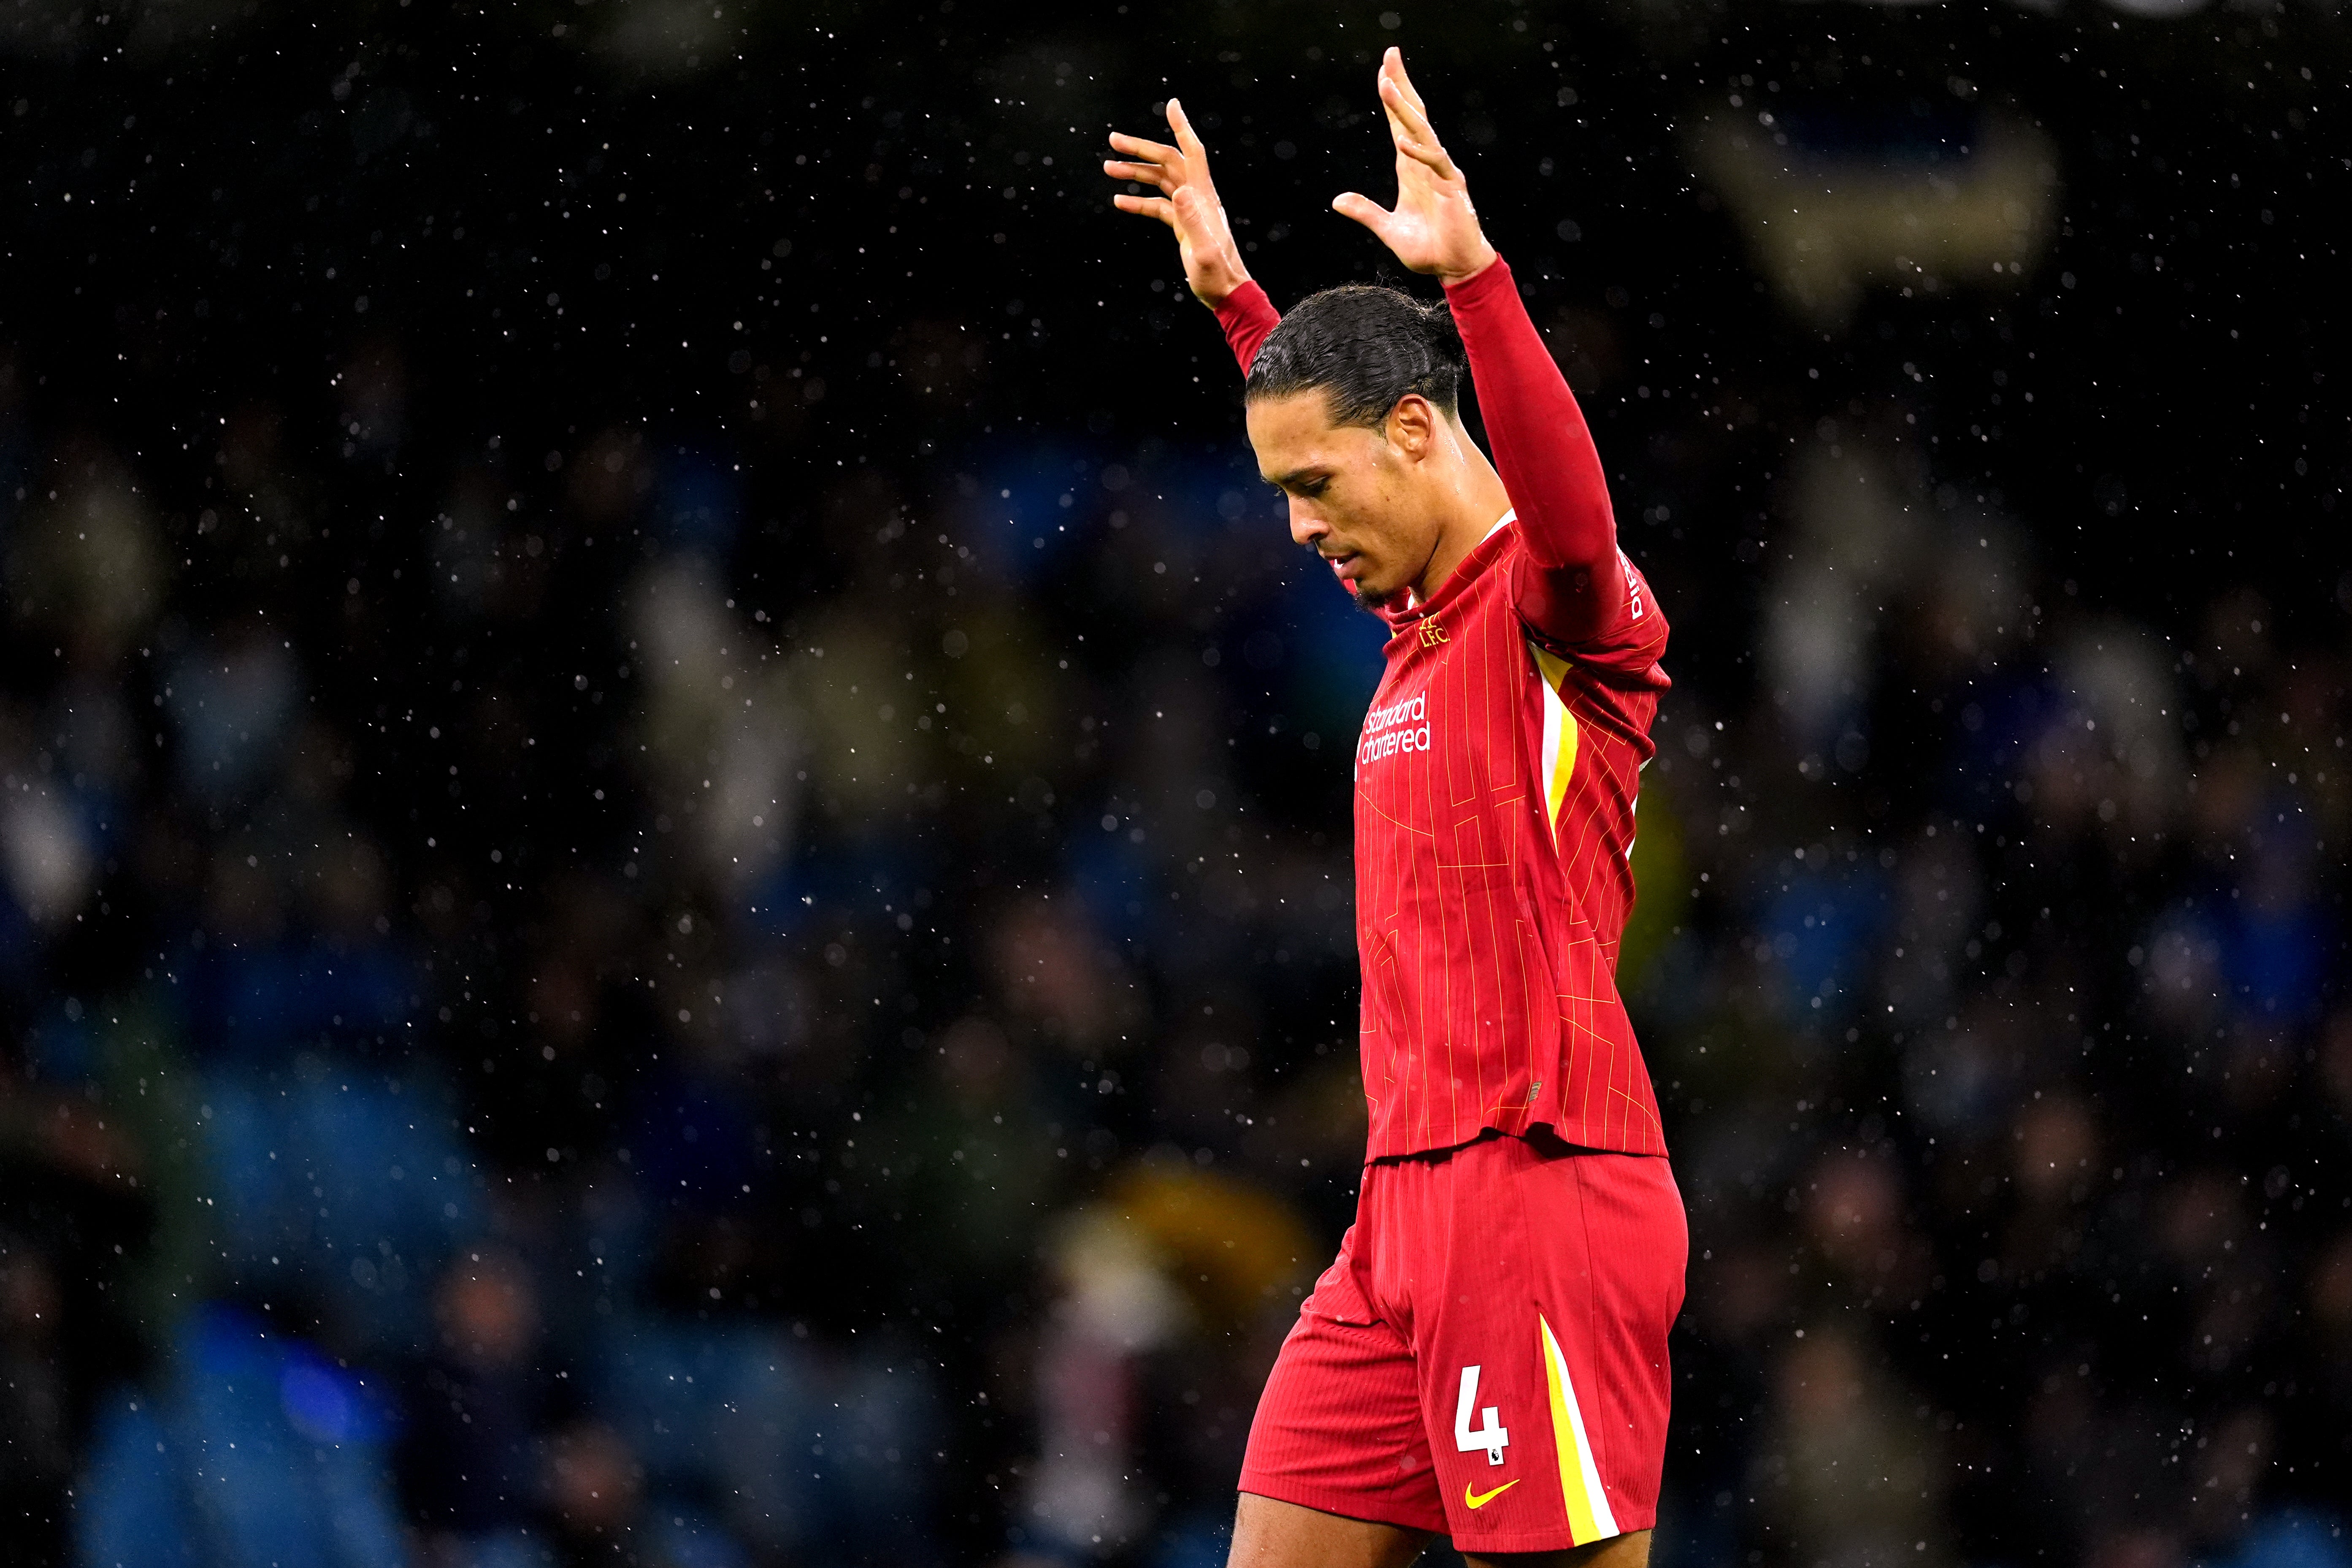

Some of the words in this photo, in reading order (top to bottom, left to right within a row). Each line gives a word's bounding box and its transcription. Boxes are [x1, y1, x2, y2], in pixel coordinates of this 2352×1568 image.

[1366, 690, 1425, 734] standard
[1362, 721, 1430, 765] chartered
[1454, 1365, 1509, 1466] 4
